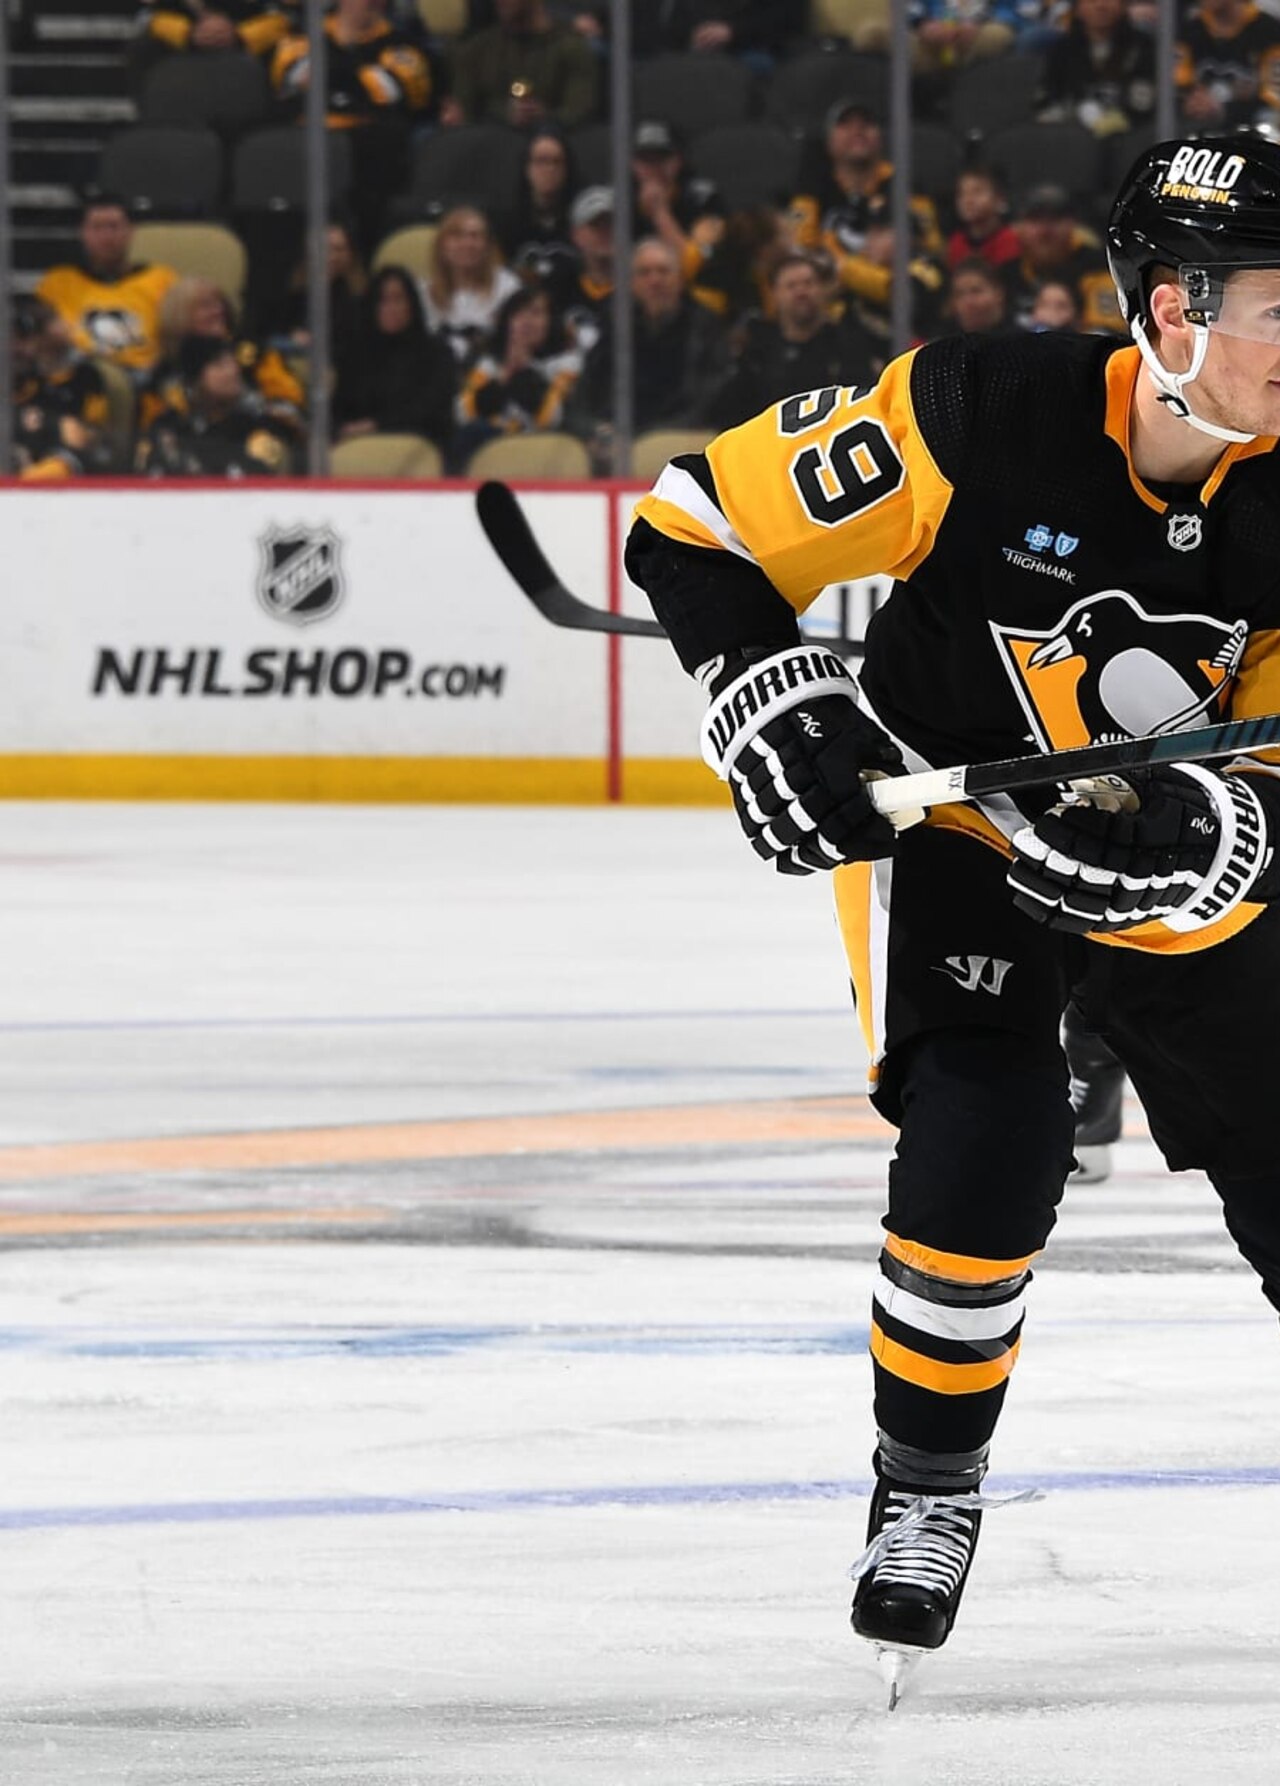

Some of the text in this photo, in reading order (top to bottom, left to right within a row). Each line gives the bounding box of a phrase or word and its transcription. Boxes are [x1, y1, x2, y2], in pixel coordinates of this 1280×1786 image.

[1167, 146, 1246, 189] BOLD
[1161, 183, 1230, 204] PENGUIN
[1002, 547, 1077, 586] HIGHMARK
[93, 648, 505, 698] NHLSHOP.COM
[708, 652, 855, 762] WARRIO
